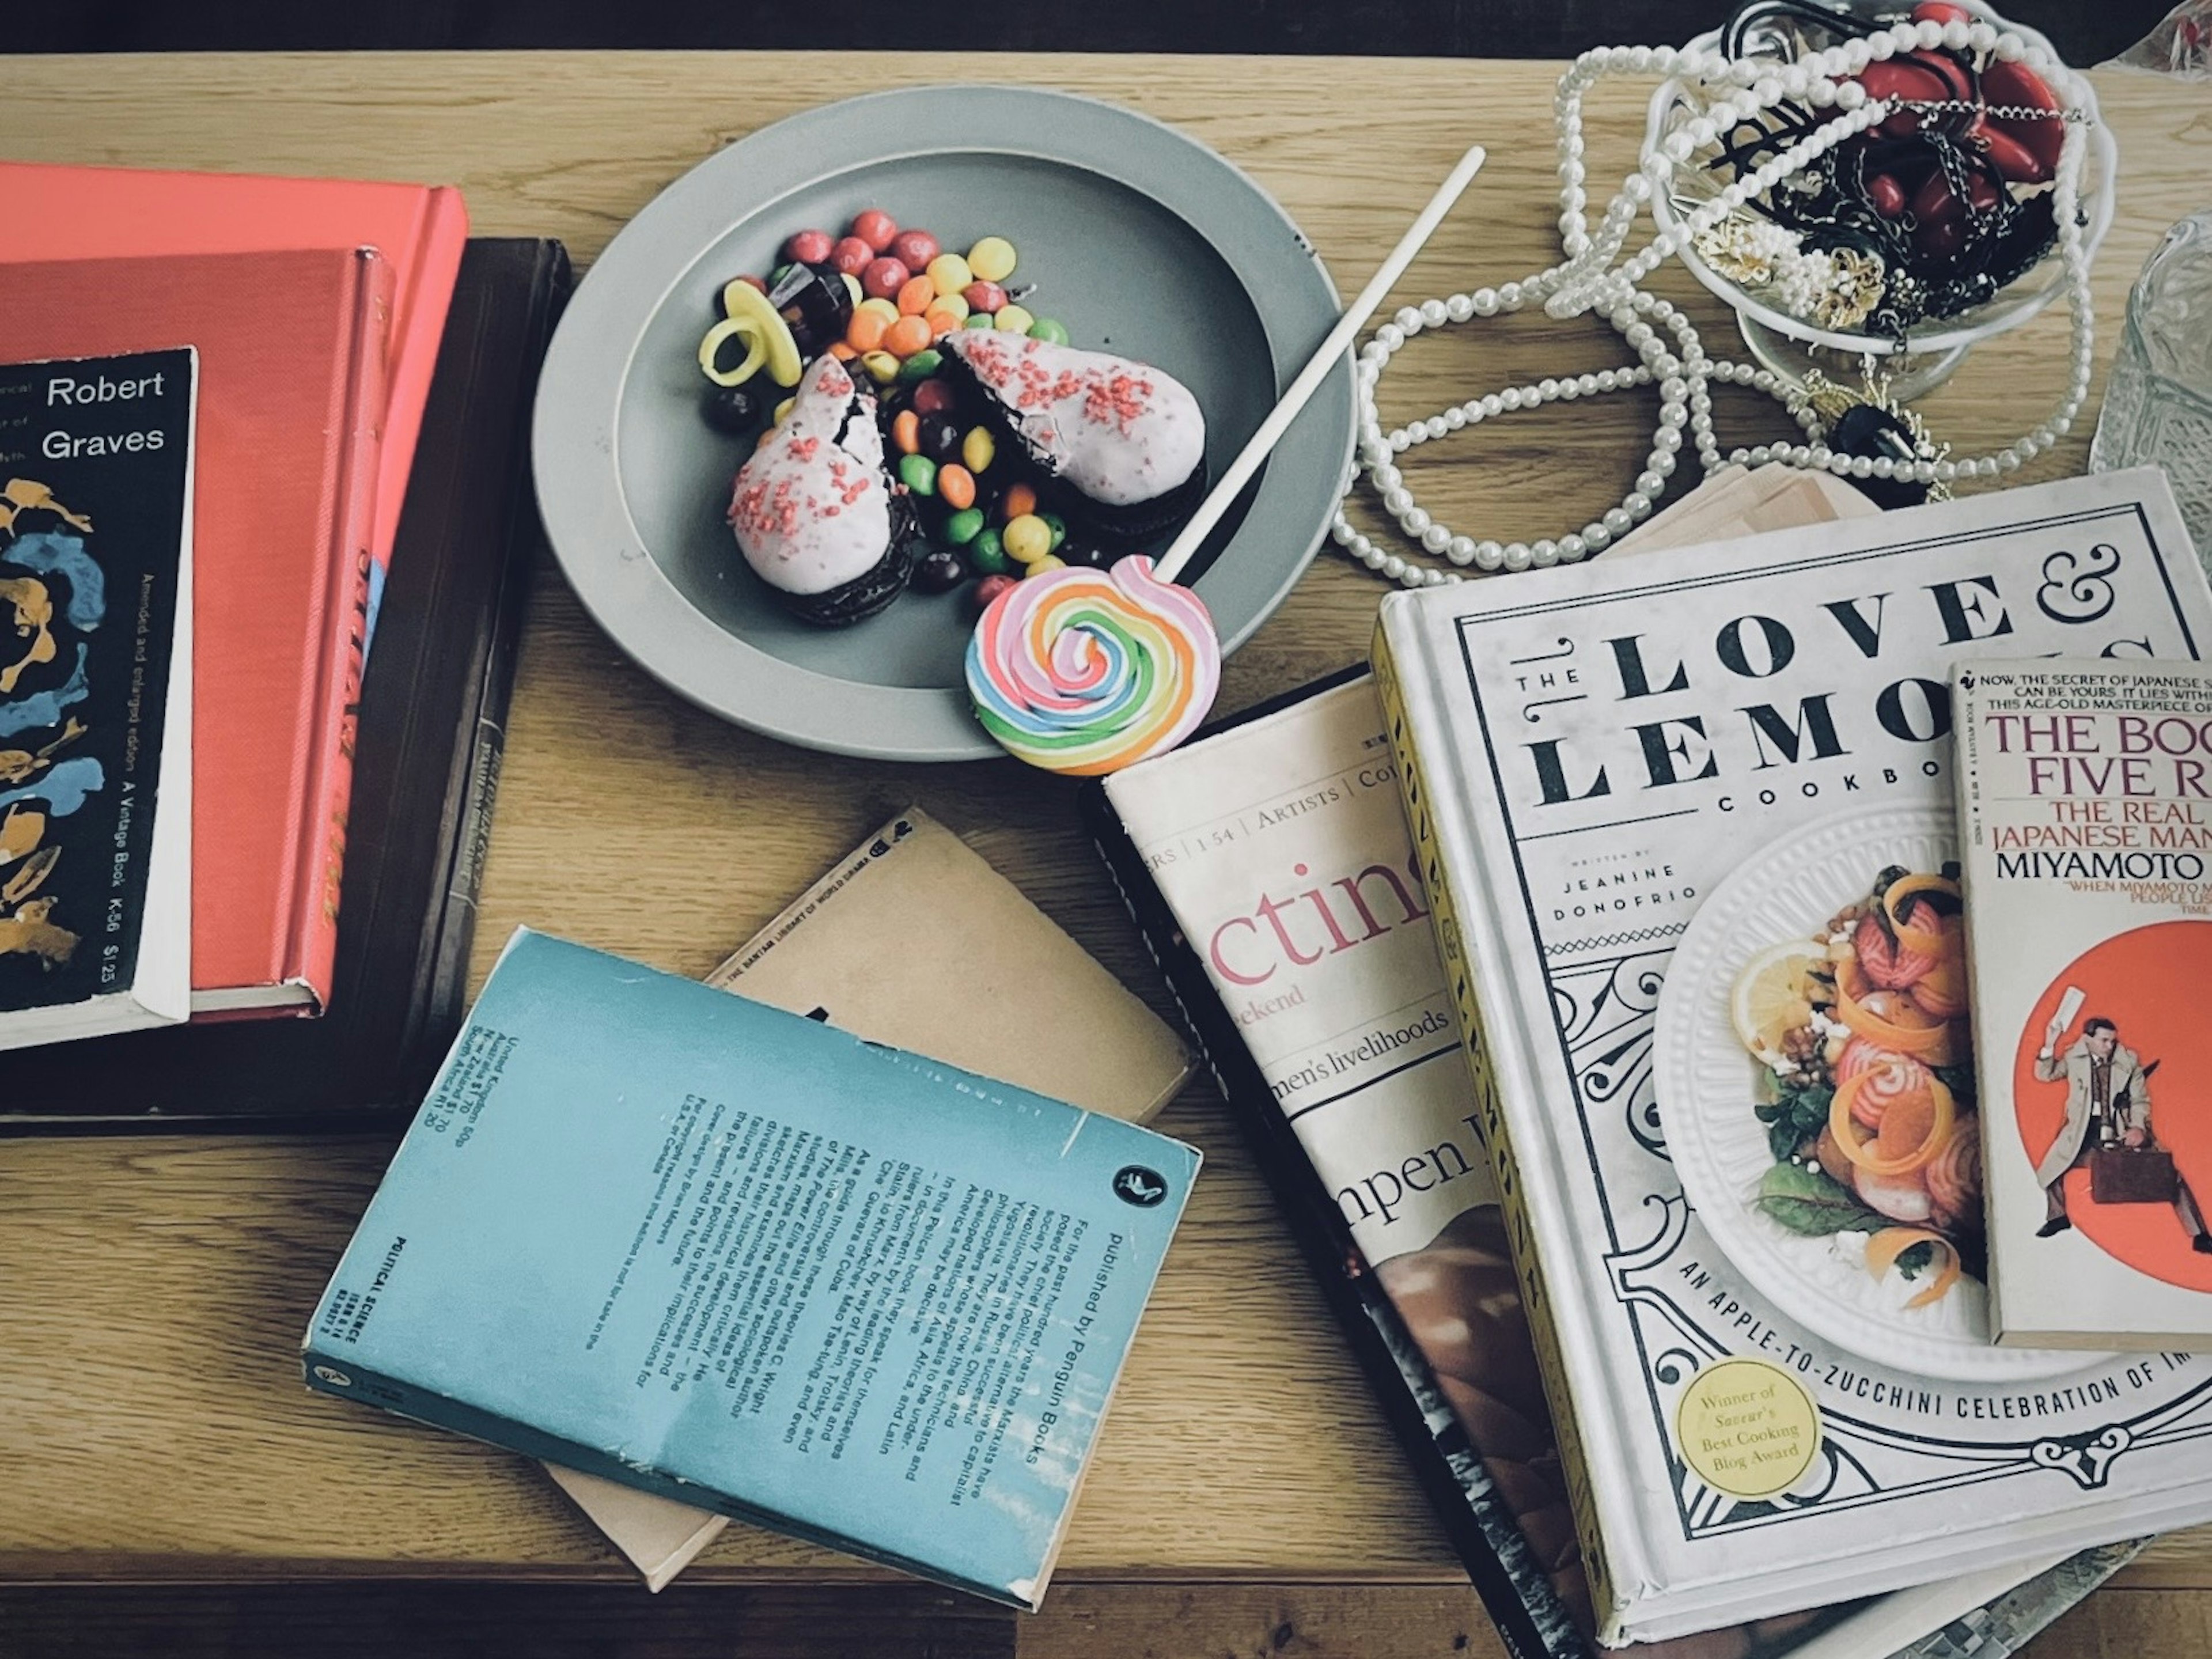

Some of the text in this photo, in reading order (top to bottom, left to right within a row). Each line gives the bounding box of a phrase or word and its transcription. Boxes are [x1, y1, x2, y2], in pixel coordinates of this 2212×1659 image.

[47, 372, 165, 407] Robert
[42, 429, 165, 460] Graves
[137, 574, 154, 634] Amended
[1601, 544, 2119, 701] LOVE &
[135, 638, 146, 661] and
[127, 667, 144, 723] enlarged
[1516, 669, 1580, 692] THE
[2014, 687, 2044, 698] CAN
[2048, 687, 2067, 697] BE
[2123, 688, 2135, 699] IT
[2139, 689, 2169, 699] LIES
[2019, 675, 2049, 685] THE
[2051, 674, 2107, 686] SECRET
[2109, 675, 2130, 687] OF
[2133, 676, 2200, 688] JAPANESE
[1988, 699, 2021, 710] THIS
[2092, 698, 2190, 712] MASTERPIECE
[1985, 715, 2100, 753] THE
[122, 781, 135, 792] A
[1718, 761, 1941, 812] COOKBO
[2027, 757, 2156, 796] FIVE
[2173, 758, 2212, 799] R
[114, 797, 133, 847] Vintage
[2048, 801, 2205, 825] THE REAL
[1992, 824, 2141, 851] JAPANESE
[2149, 825, 2212, 849] MAN
[112, 852, 128, 887] Book
[1565, 865, 1672, 893] JEANINE
[1996, 851, 2204, 880] MIYAMOTO
[1554, 887, 1695, 920] DONOFRIO
[2119, 881, 2199, 893] MIYAMOTO
[2131, 892, 2187, 904] PEOPLE
[742, 940, 775, 968] BANTAM
[816, 880, 843, 903] WORLD
[1210, 862, 1429, 986] ctin
[460, 1025, 483, 1056] South
[476, 1032, 506, 1079] Australia
[494, 1036, 519, 1073] United
[1331, 1010, 1449, 1075] livelihoods
[441, 1059, 464, 1092] Africa
[452, 1056, 480, 1099] Zealand
[468, 1075, 498, 1123] Kingdom
[736, 1116, 763, 1160] failures
[717, 1180, 733, 1205] and
[902, 1166, 923, 1200] rulers
[699, 1206, 721, 1243] points
[891, 1204, 910, 1232] from
[961, 1189, 993, 1251] developed
[971, 1194, 1008, 1271] philosophers
[692, 1247, 706, 1259] to
[725, 1140, 838, 1388] of The Power Elite and other sociological
[345, 1237, 406, 1343] POLITICAL SCIENCE
[679, 1262, 698, 1291] their
[866, 1271, 881, 1287] by
[942, 1253, 966, 1298] nations
[854, 1289, 872, 1314] way
[936, 1301, 947, 1315] of
[953, 1275, 975, 1314] whose
[645, 1293, 683, 1366] implications
[831, 1176, 956, 1459] In this Pelican book they speak for themselves
[849, 1316, 860, 1330] of
[933, 1317, 957, 1365] appeals
[1026, 1233, 1122, 1463] published by Penguin Books
[1680, 1261, 2154, 1419] AN APPLE-TO-ZUCCHINI CELEBRATION OF
[926, 1368, 940, 1381] to
[971, 1219, 1088, 1498] For the past hundred years the Marxists have
[635, 1370, 650, 1388] for
[916, 1384, 933, 1404] the
[893, 1395, 909, 1420] and
[1700, 1383, 1775, 1409] Winner of
[798, 1427, 814, 1453] and
[878, 1422, 900, 1455] Latin
[1702, 1426, 1799, 1452] Best Cooking
[1713, 1442, 1798, 1471] Blog Award
